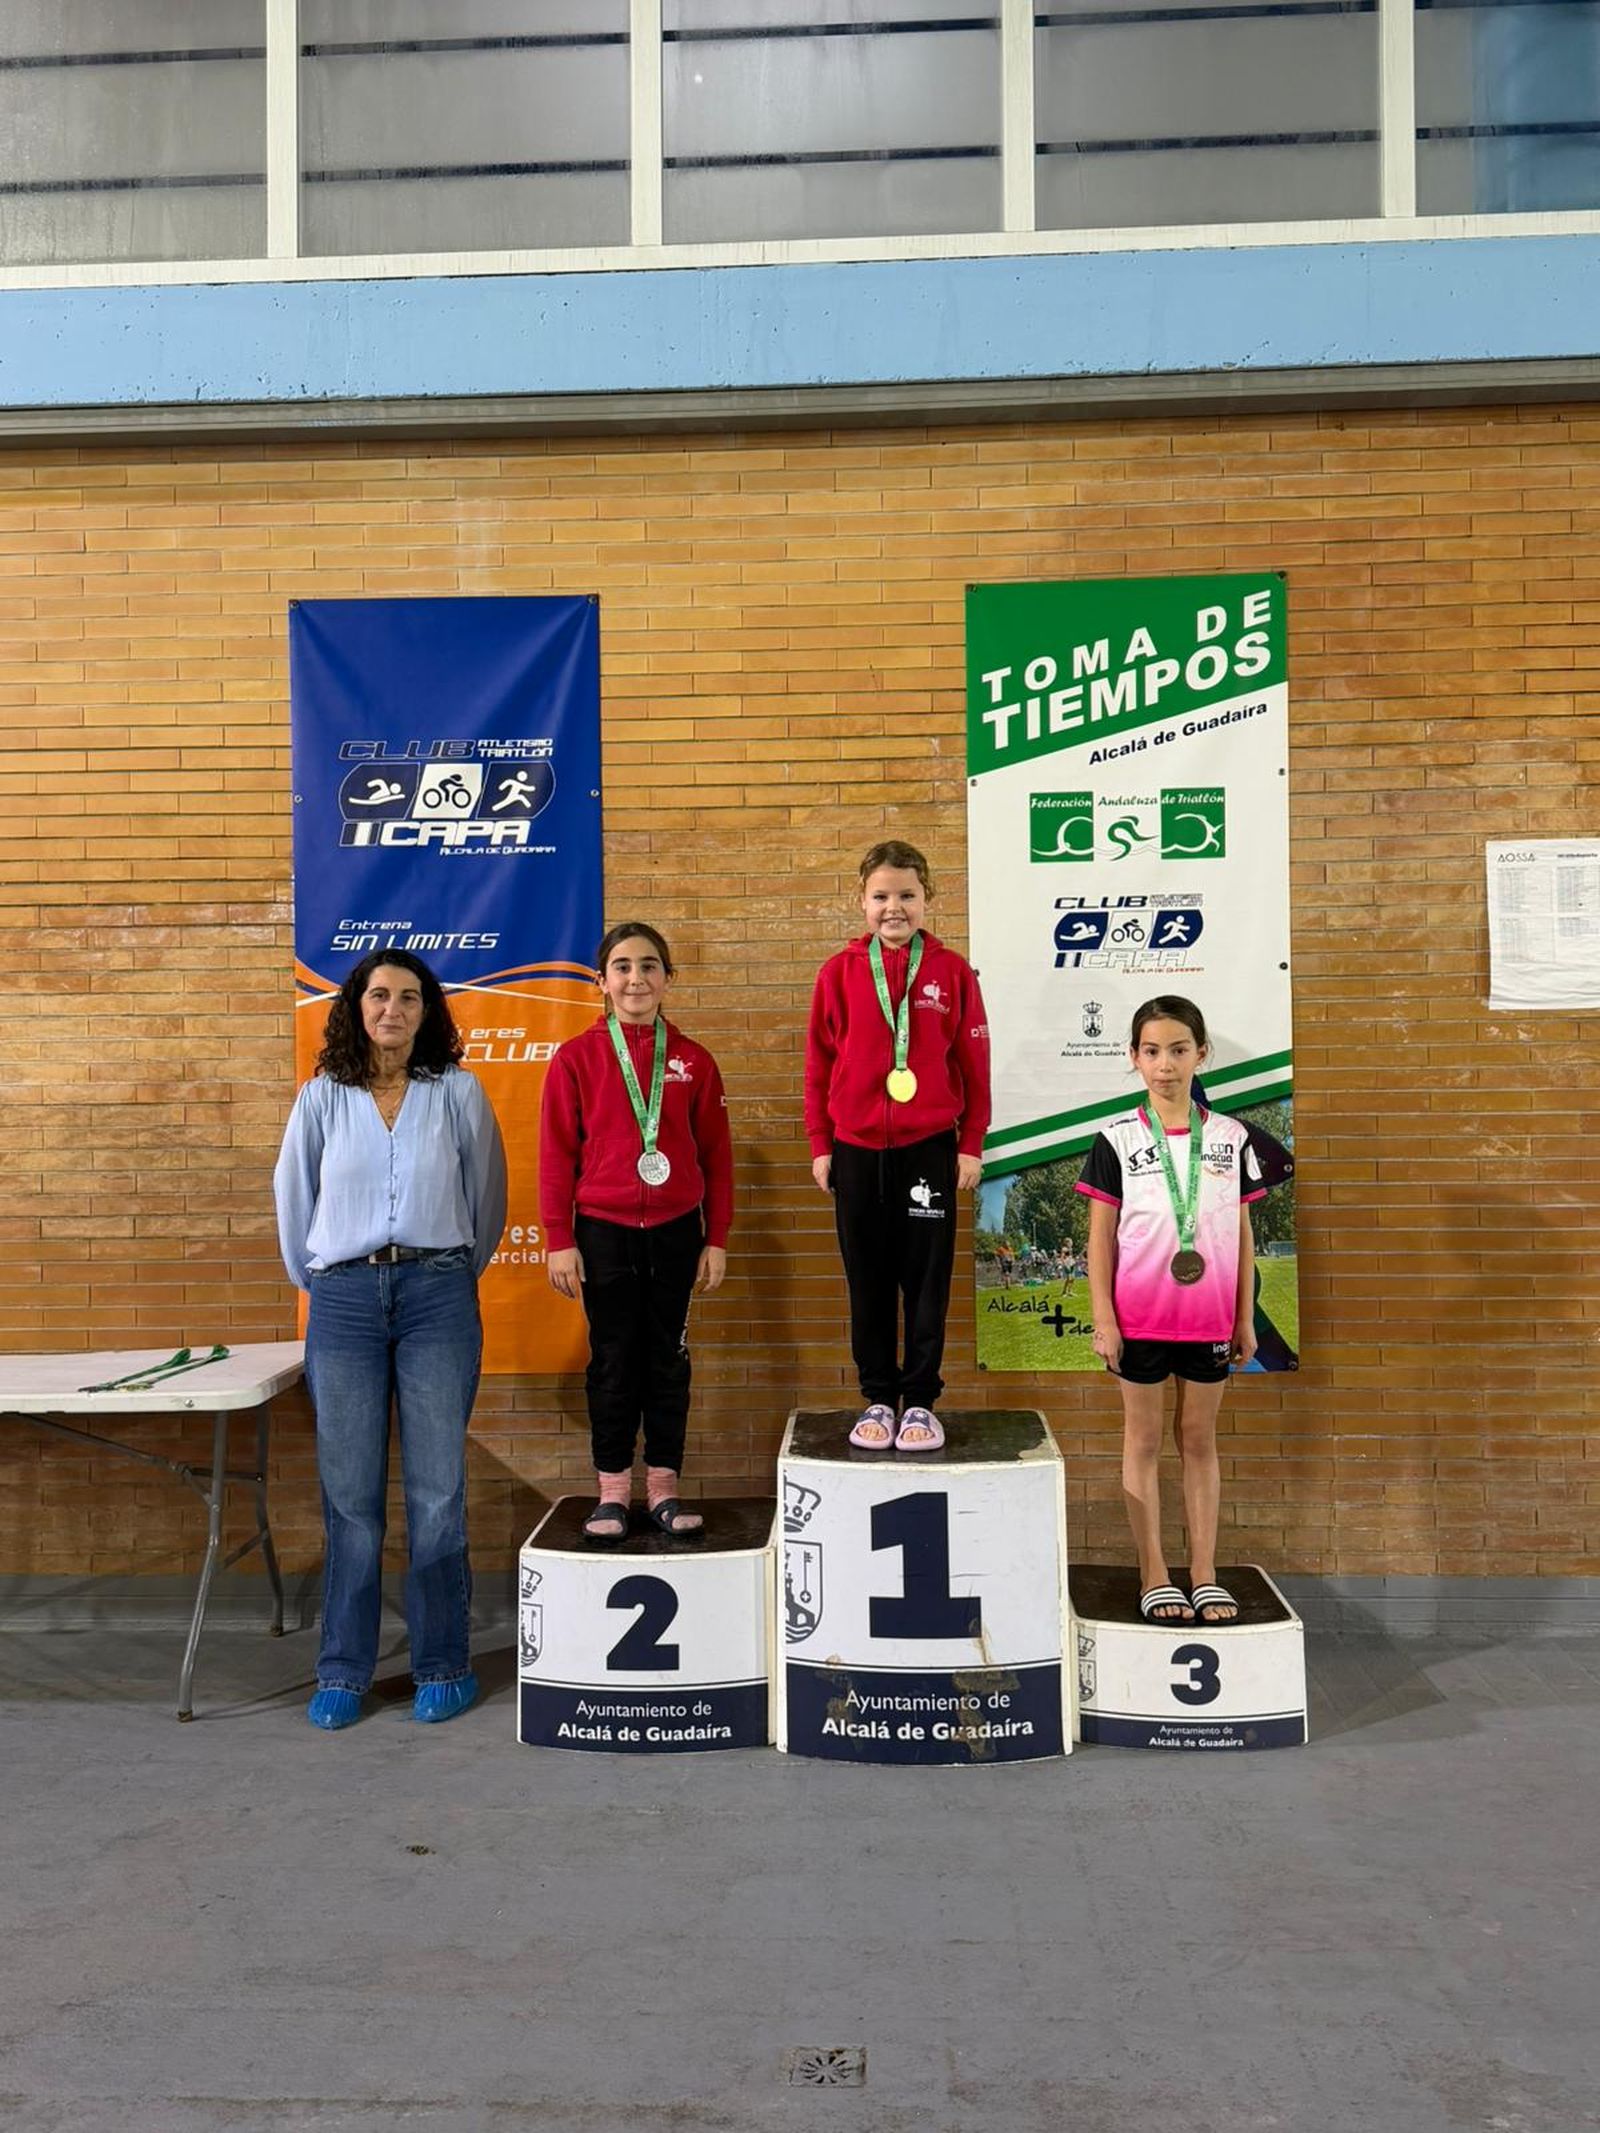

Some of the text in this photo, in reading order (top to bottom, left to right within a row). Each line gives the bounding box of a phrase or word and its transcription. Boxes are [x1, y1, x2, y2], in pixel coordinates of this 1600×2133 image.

[982, 590, 1272, 703] TOMA DE
[982, 631, 1272, 750] TIEMPOS
[477, 738, 553, 748] ATLETISMO
[1089, 702, 1268, 765] Alcalá de Guadaíra
[339, 740, 476, 760] CLUB
[1030, 793, 1226, 809] Federación Andaluza de Triatlón
[1054, 895, 1149, 909] CLUB
[338, 919, 412, 931] Entrena
[330, 932, 500, 951] SIN LIMITES
[470, 1027, 527, 1039] eres
[987, 1295, 1050, 1313] Alcalá
[870, 1491, 982, 1638] 1
[606, 1574, 680, 1671] 2
[1170, 1643, 1221, 1706] 3
[576, 1699, 712, 1720] Ayuntamiento de
[845, 1689, 1011, 1714] Ayuntamiento de
[557, 1722, 732, 1742] Alcalá de Guadaíra
[821, 1717, 890, 1740] Alcalá
[897, 1722, 925, 1740] de
[1160, 1724, 1234, 1736] Ayuntamiento de
[1149, 1736, 1180, 1747] Alcalá
[1183, 1738, 1197, 1747] de
